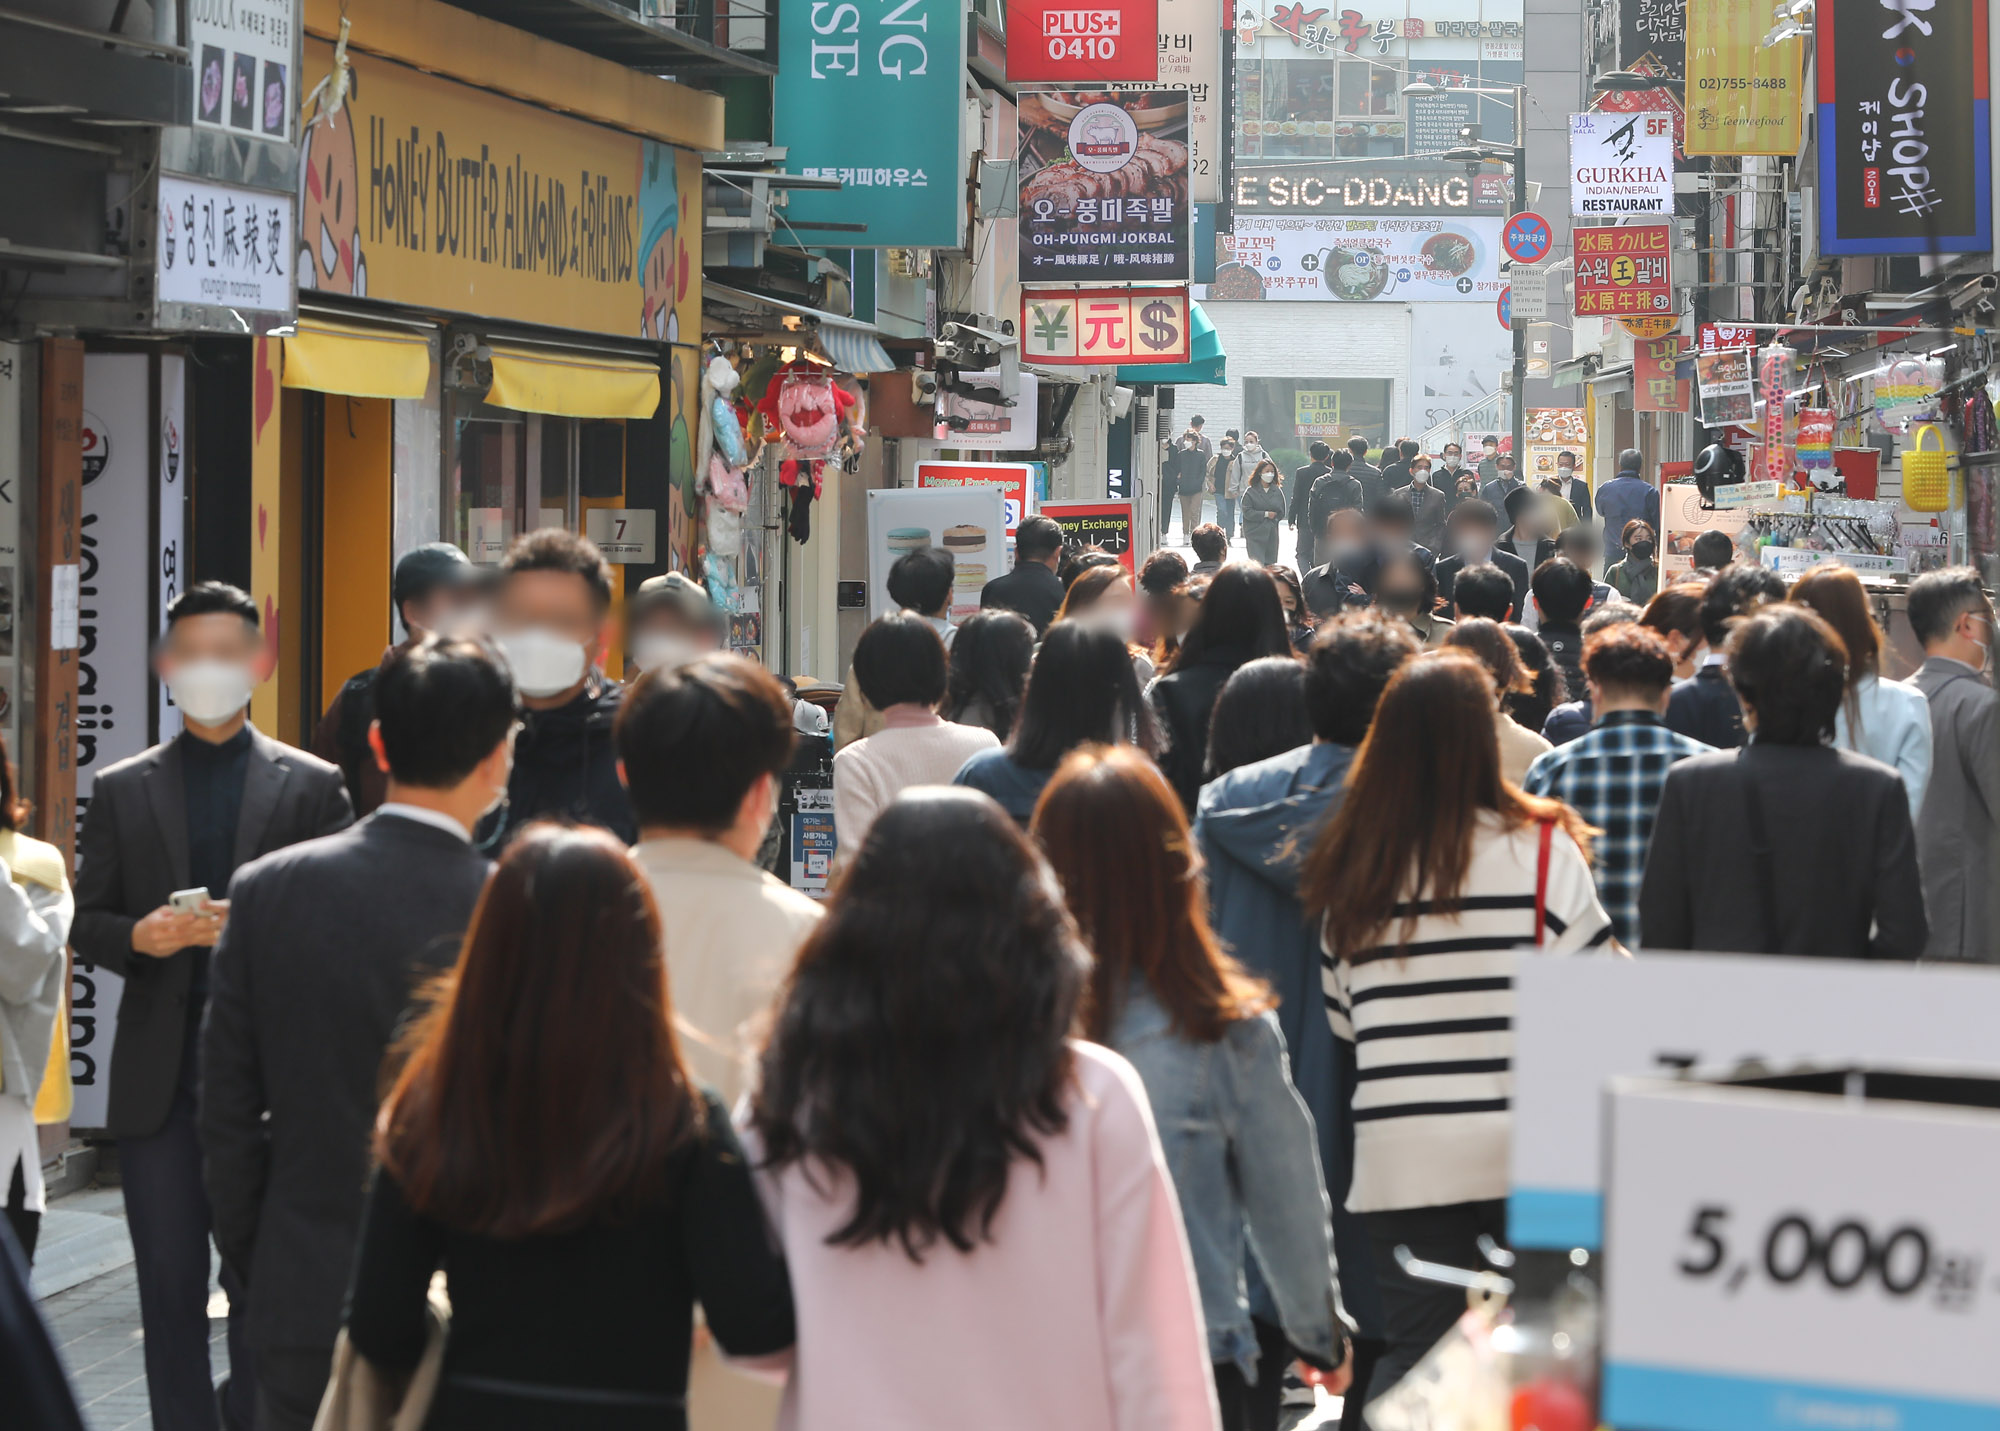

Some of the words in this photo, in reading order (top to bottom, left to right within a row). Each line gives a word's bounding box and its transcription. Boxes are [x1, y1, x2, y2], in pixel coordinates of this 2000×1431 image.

[1045, 13, 1118, 34] PLUS+
[1636, 15, 1680, 31] 디저트
[811, 2, 860, 79] SE
[1048, 37, 1115, 60] 0410
[1168, 55, 1192, 63] Galbi
[1699, 78, 1786, 90] 02)755-8488
[1646, 118, 1668, 135] 5F
[1859, 101, 1882, 161] 케이샵
[1576, 166, 1667, 183] GURKHA
[1268, 176, 1469, 206] SIC-DDANG
[1585, 185, 1659, 195] INDIAN/NEPALI
[1866, 171, 1877, 205] 2019
[436, 131, 497, 264] BUTTER
[581, 170, 632, 283] FRIENDS
[1033, 197, 1174, 224] 오-풍미족발
[1582, 199, 1663, 211] RESTAURANT
[1032, 233, 1116, 245] OH-PUNGMI
[1119, 232, 1175, 244] JOKBAL
[1224, 236, 1276, 251] 벌교꼬막
[1510, 233, 1545, 242] 주정차금지
[1578, 233, 1614, 251] 水原
[1618, 232, 1665, 250] カルビ
[1236, 252, 1262, 267] 무침
[1268, 259, 1281, 268] or
[1356, 255, 1369, 264] or
[1397, 270, 1411, 279] or
[1263, 276, 1318, 289] 불맛쭈꾸미
[1477, 281, 1510, 291] 참기름비
[1580, 291, 1652, 311] 水原牛排
[1655, 296, 1669, 306] 3F
[1084, 303, 1126, 350] 元
[1737, 329, 1753, 339] 2F
[1648, 338, 1680, 408] 냉면
[1301, 395, 1337, 409] 임대
[1315, 412, 1337, 423] 80평
[1425, 408, 1500, 431] SOLARIA
[615, 519, 627, 540] 7
[1061, 522, 1079, 532] oney
[1082, 519, 1128, 531] Exchange
